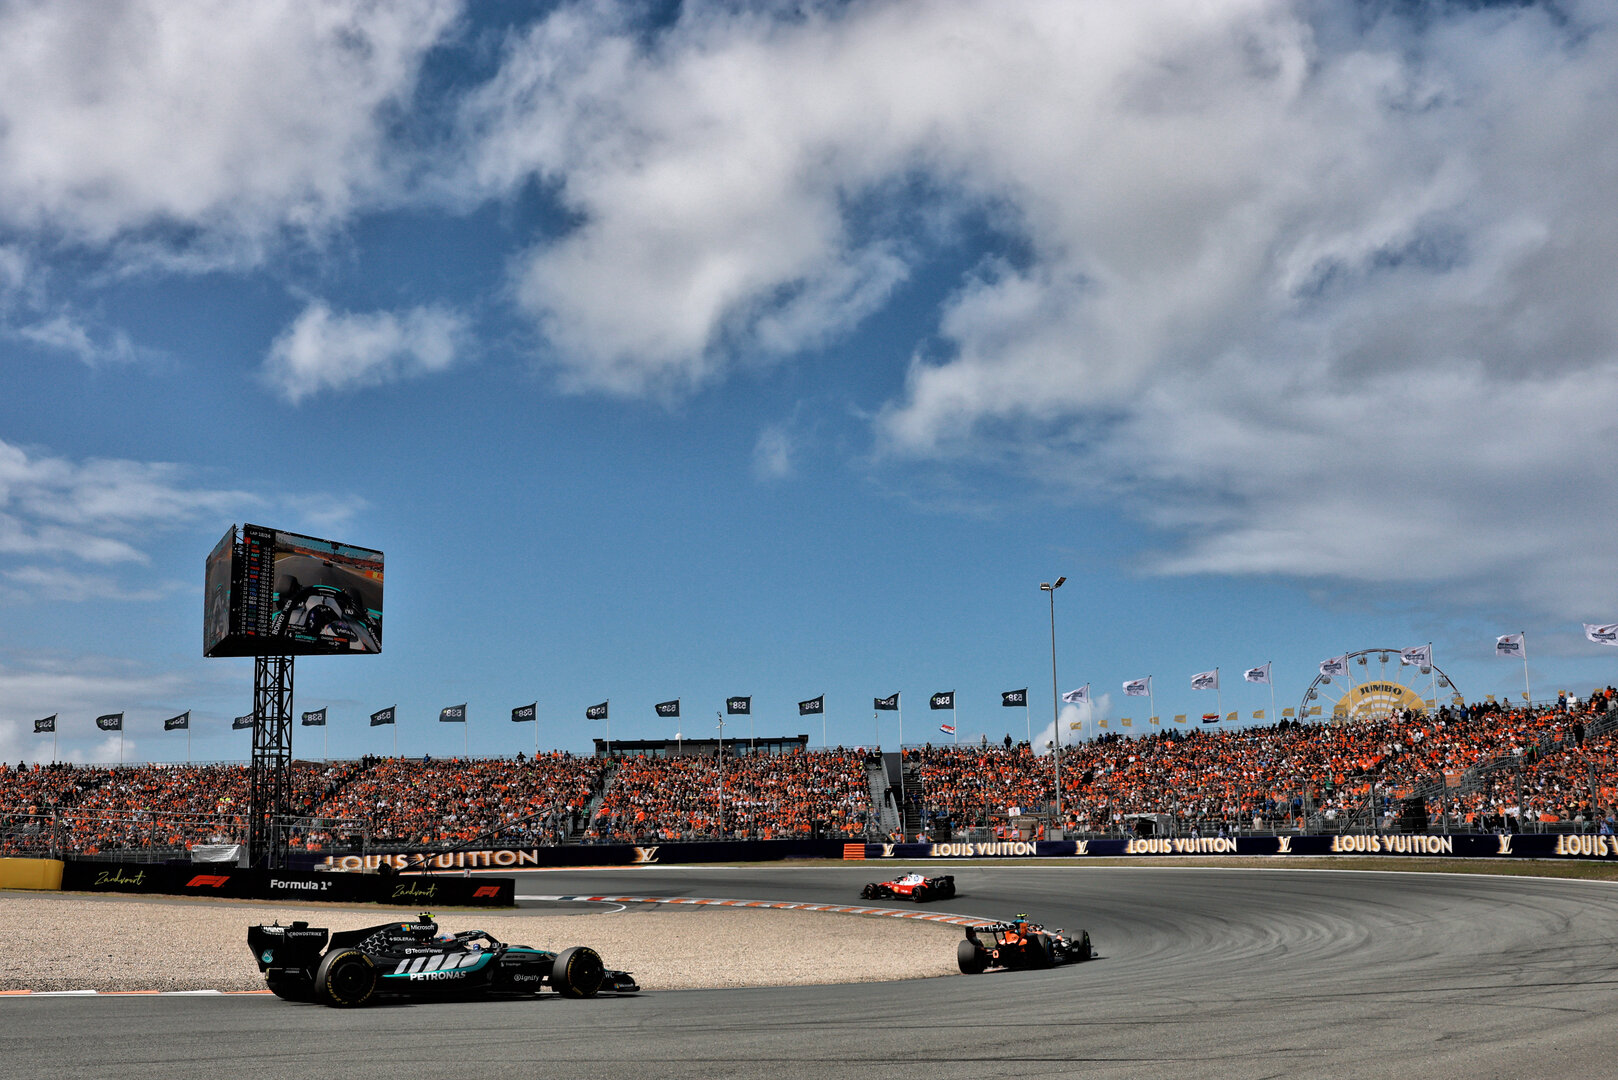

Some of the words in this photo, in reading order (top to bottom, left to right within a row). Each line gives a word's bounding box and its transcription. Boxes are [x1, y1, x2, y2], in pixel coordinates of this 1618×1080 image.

[1359, 684, 1403, 696] JUMBO
[932, 843, 974, 857] LOUIS
[977, 841, 1037, 856] VUITTON
[1127, 838, 1171, 854] LOUIS
[1174, 837, 1237, 854] VUITTON
[1332, 835, 1380, 853] LOUIS
[1383, 835, 1453, 854] VUITTON
[1558, 835, 1608, 857] LOUIS
[415, 849, 539, 870] VUITTON
[94, 868, 147, 886] Zandvoort
[185, 874, 231, 888] F1
[270, 879, 319, 890] Formula
[391, 881, 438, 898] Zandvoort
[472, 886, 501, 898] F1
[409, 970, 467, 981] PETRONAS
